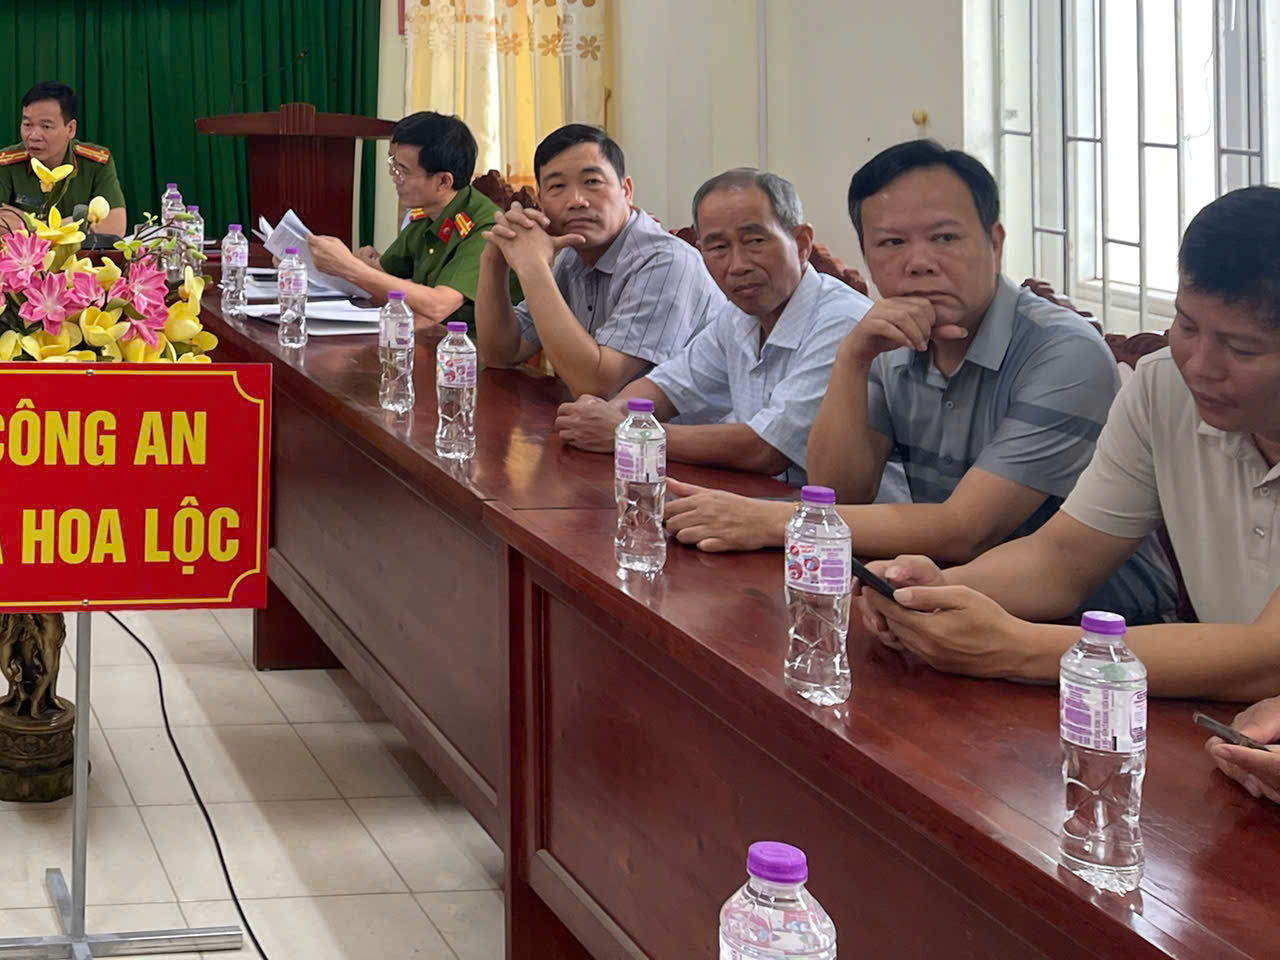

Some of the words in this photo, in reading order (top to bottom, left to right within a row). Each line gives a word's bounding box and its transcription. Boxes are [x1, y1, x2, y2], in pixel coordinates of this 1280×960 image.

[133, 410, 208, 466] AN
[21, 507, 127, 565] HOA
[143, 495, 241, 575] LỘC
